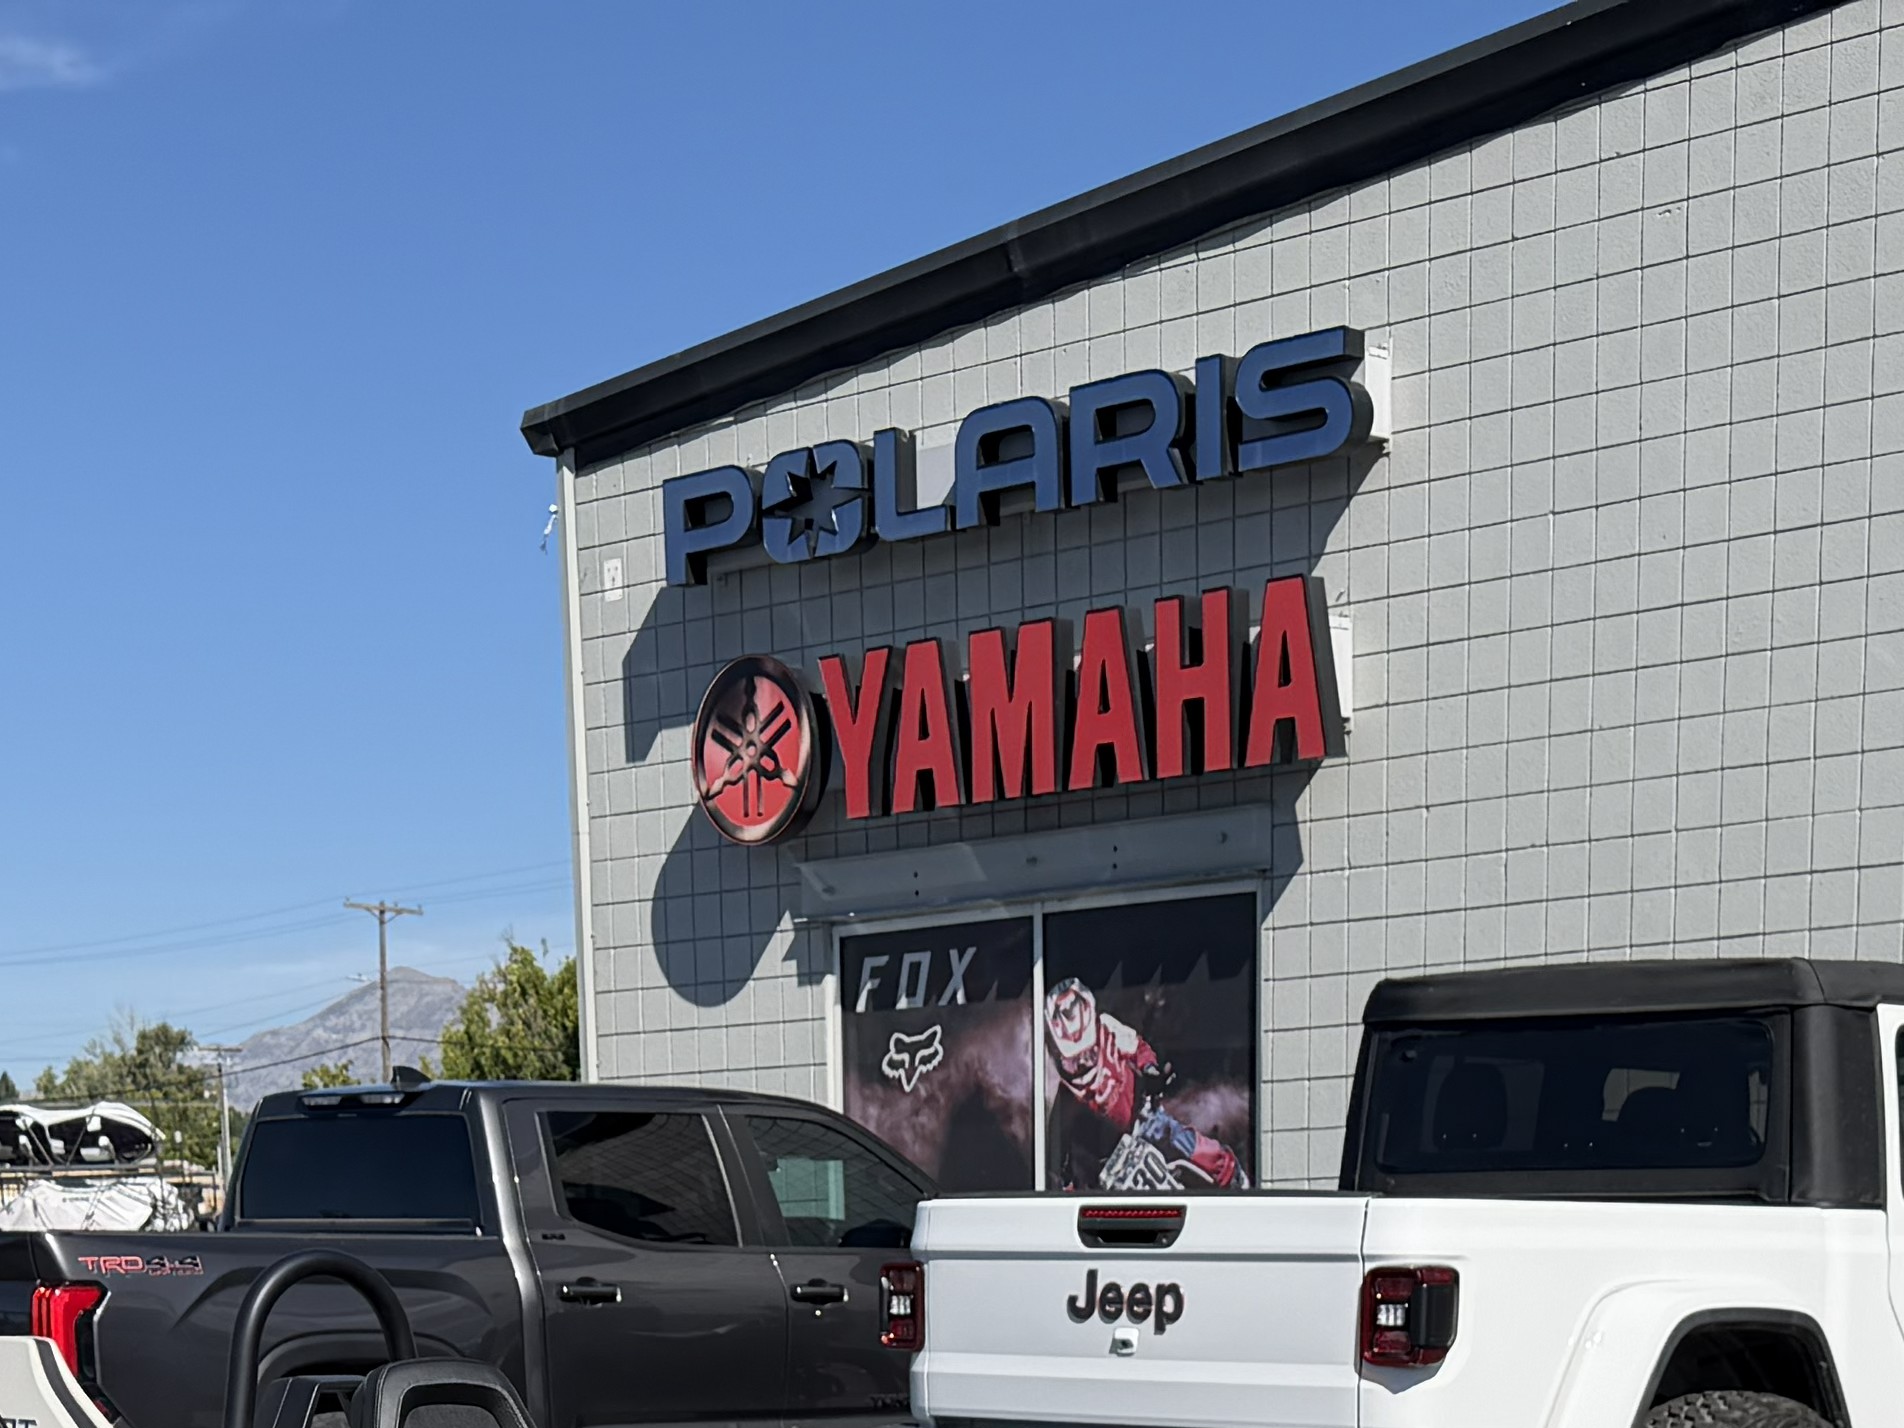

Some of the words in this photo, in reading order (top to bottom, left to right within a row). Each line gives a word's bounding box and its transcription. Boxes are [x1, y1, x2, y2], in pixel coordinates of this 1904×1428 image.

[664, 325, 1373, 587] POLARIS
[819, 573, 1336, 820] YAMAHA
[856, 946, 977, 1013] FOX
[78, 1256, 146, 1275] TRD
[1067, 1269, 1185, 1335] Jeep
